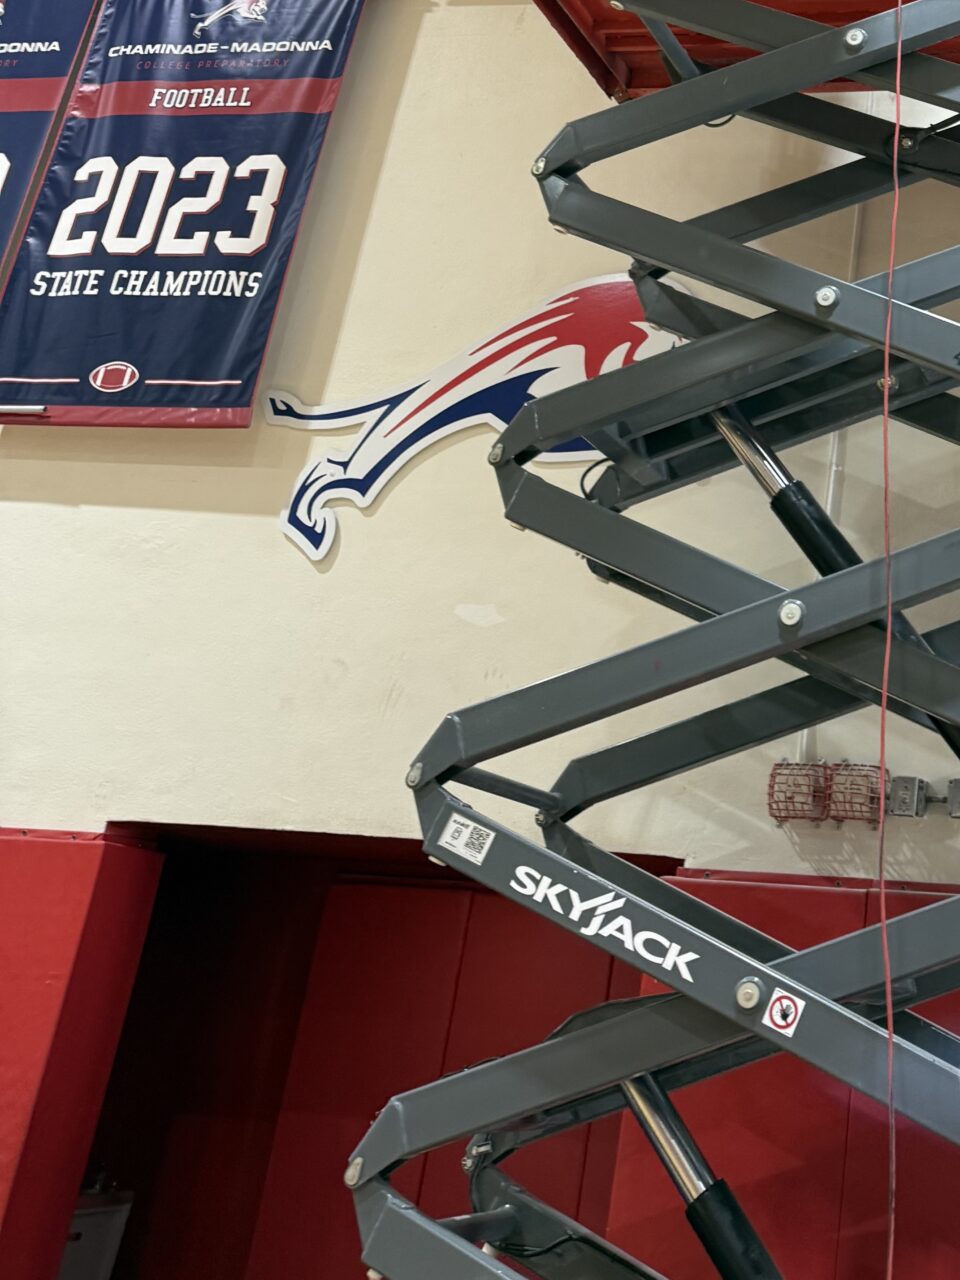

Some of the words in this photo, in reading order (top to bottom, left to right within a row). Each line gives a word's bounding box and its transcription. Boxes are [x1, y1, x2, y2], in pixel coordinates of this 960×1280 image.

[108, 39, 333, 57] CHAMINADE-MADONNA
[136, 60, 191, 70] COLLEGE
[197, 58, 290, 70] PREPARATORY
[149, 86, 251, 108] FOOTBALL
[47, 154, 287, 256] 2023
[30, 270, 105, 296] STATE
[110, 269, 263, 297] CHAMPIONS
[509, 865, 700, 983] SKYJACK
